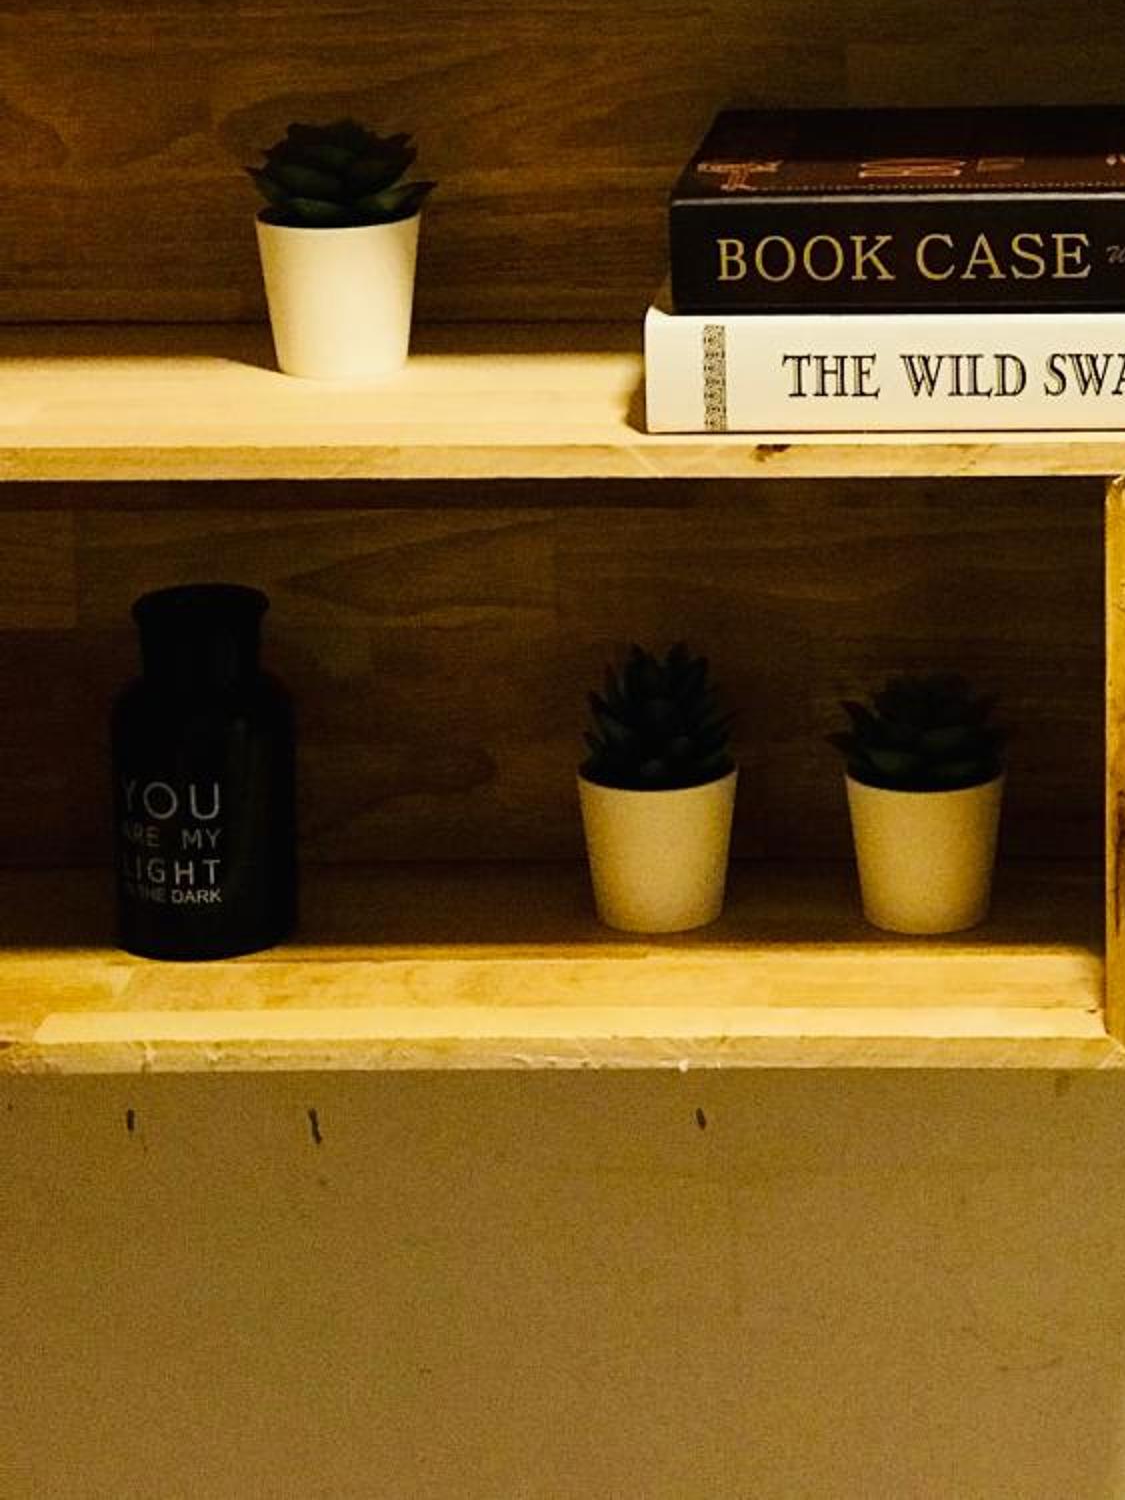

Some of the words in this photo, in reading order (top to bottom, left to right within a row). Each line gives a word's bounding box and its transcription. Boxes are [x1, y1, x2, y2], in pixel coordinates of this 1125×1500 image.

[716, 234, 895, 282] BOOK
[915, 232, 1092, 280] CASE
[782, 353, 880, 398] THE
[900, 353, 1027, 398] WILD
[181, 828, 222, 850] MY
[170, 888, 222, 904] DARK
